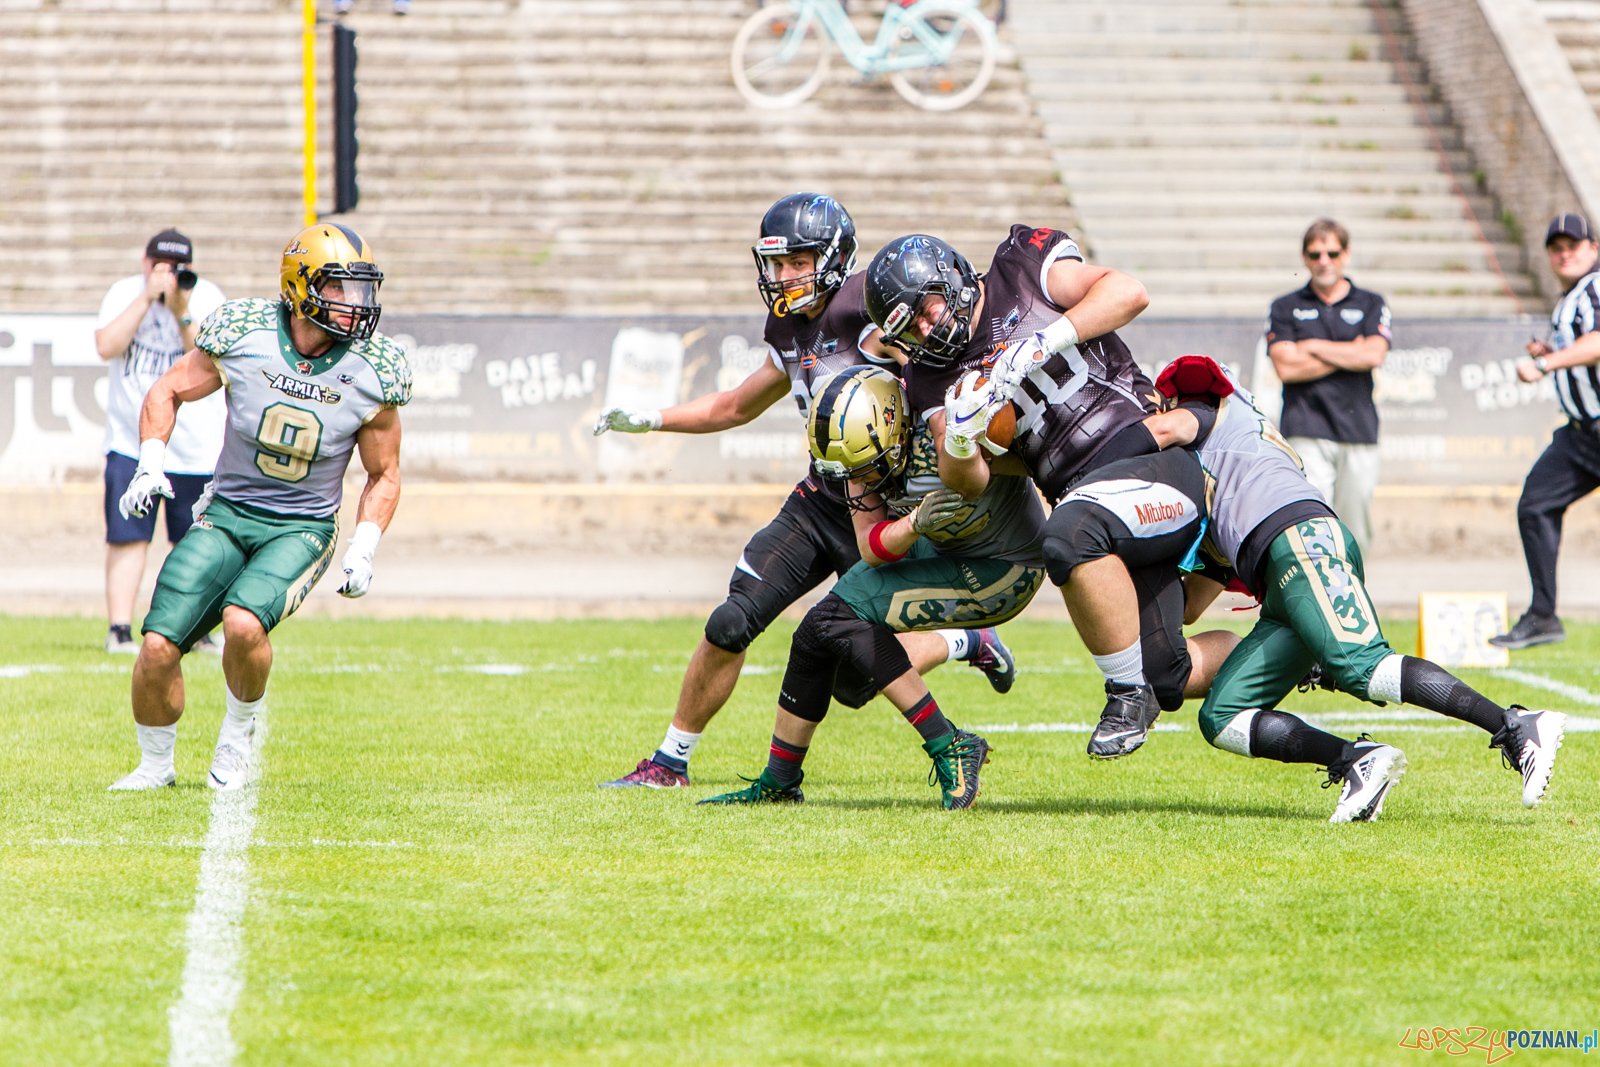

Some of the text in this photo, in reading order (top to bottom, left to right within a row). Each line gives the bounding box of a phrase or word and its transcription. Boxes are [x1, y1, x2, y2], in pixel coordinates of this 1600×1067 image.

[486, 352, 559, 387] DAJE
[501, 359, 597, 408] KOPA!
[271, 374, 323, 402] ARMIA
[255, 402, 323, 482] 9
[1134, 501, 1184, 526] Mitutoyo
[1364, 756, 1377, 782] adidas
